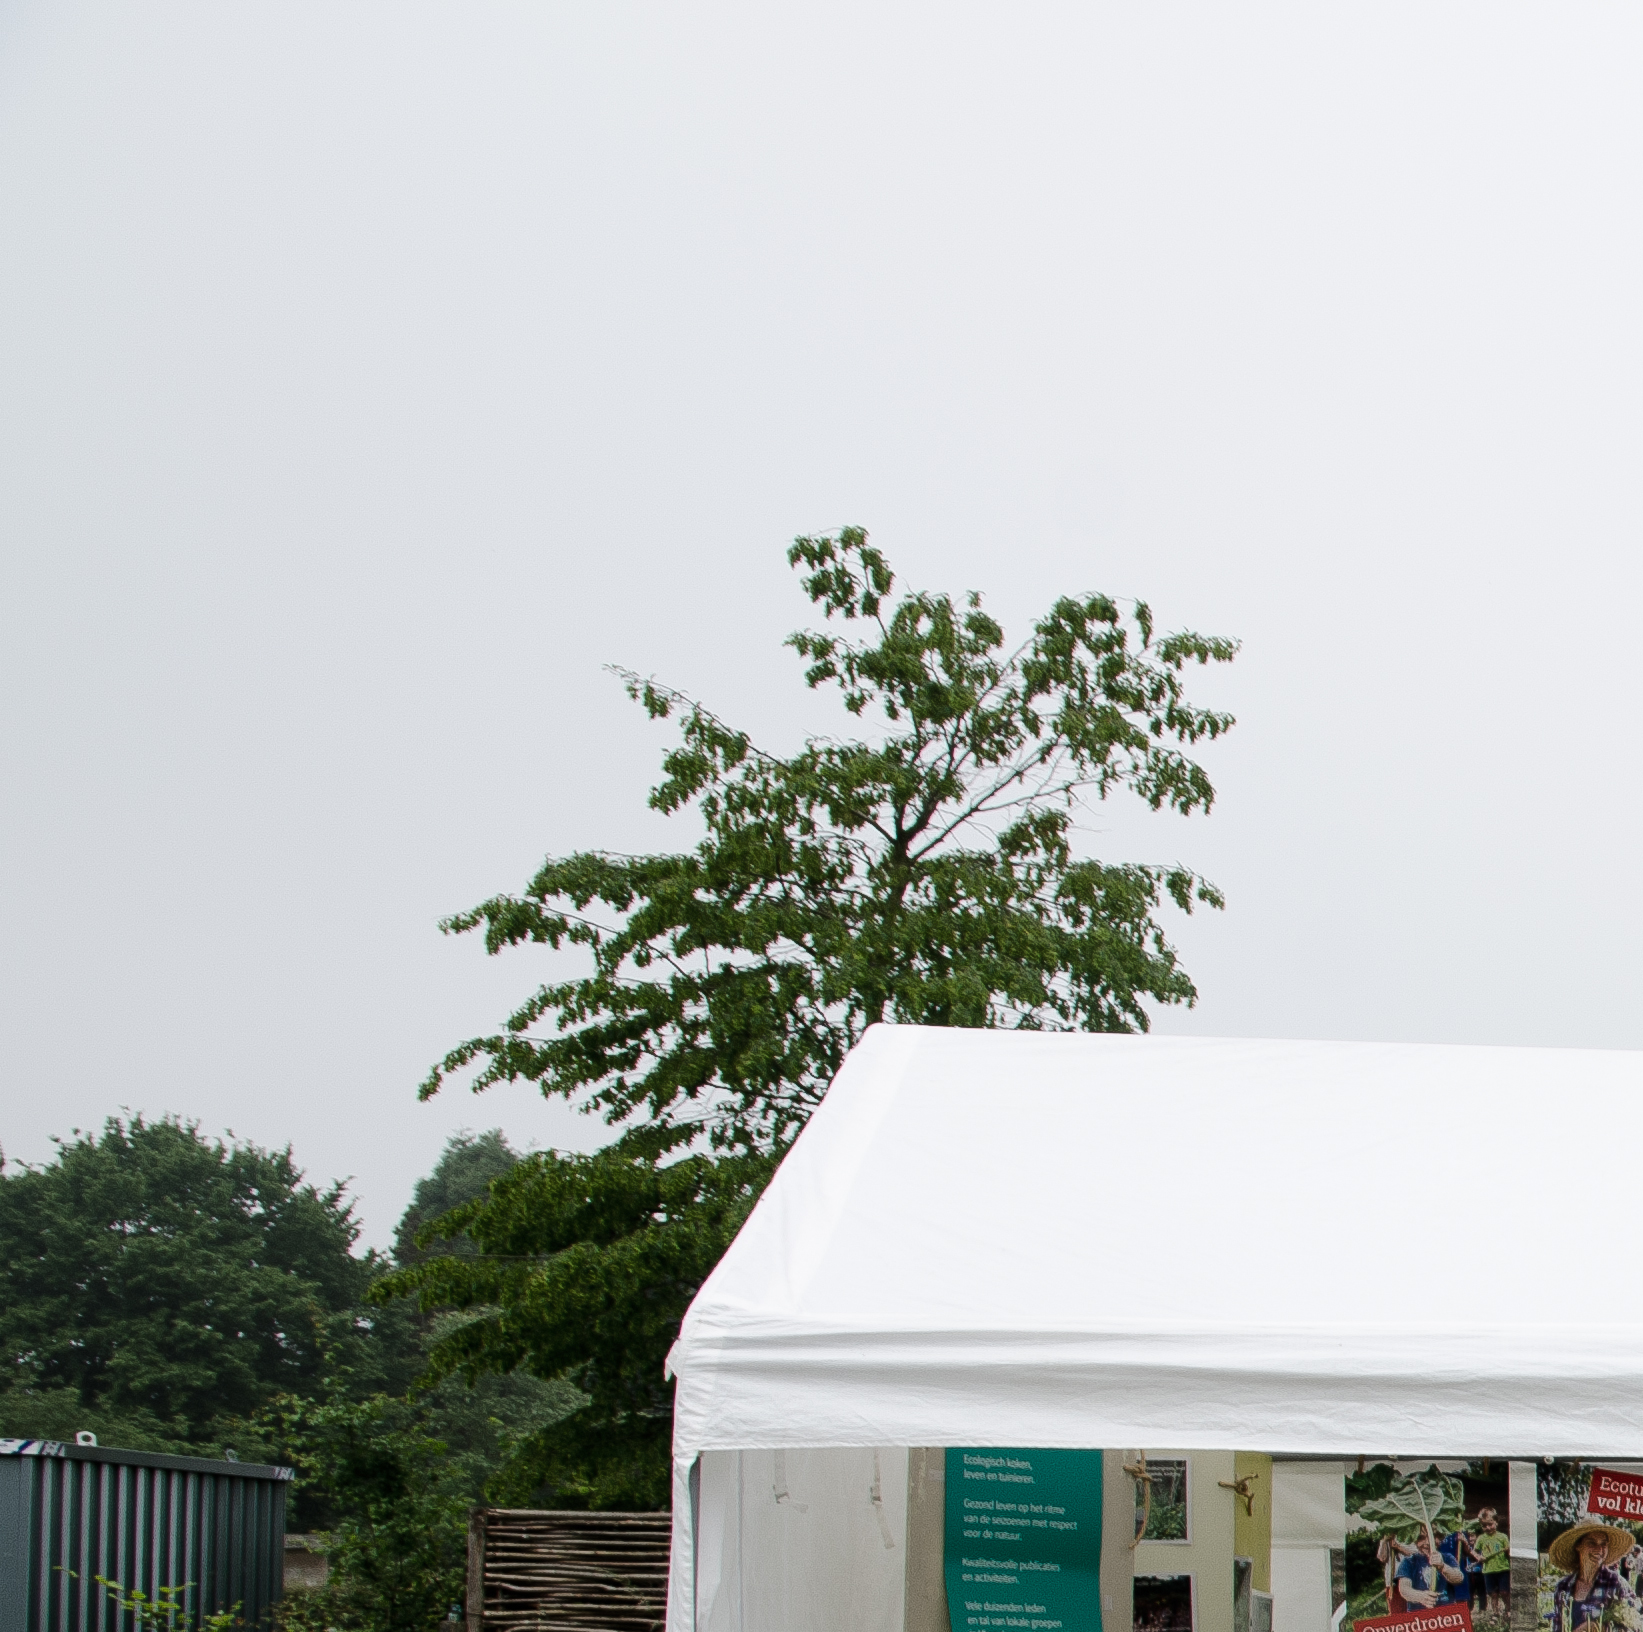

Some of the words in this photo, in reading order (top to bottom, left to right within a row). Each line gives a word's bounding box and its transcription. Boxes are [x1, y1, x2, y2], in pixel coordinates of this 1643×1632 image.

[963, 1453, 1005, 1468] Ecologisch
[963, 1498, 994, 1510] Gezond
[995, 1501, 1016, 1512] leven
[1018, 1504, 1029, 1514] op
[1597, 1495, 1620, 1511] vol
